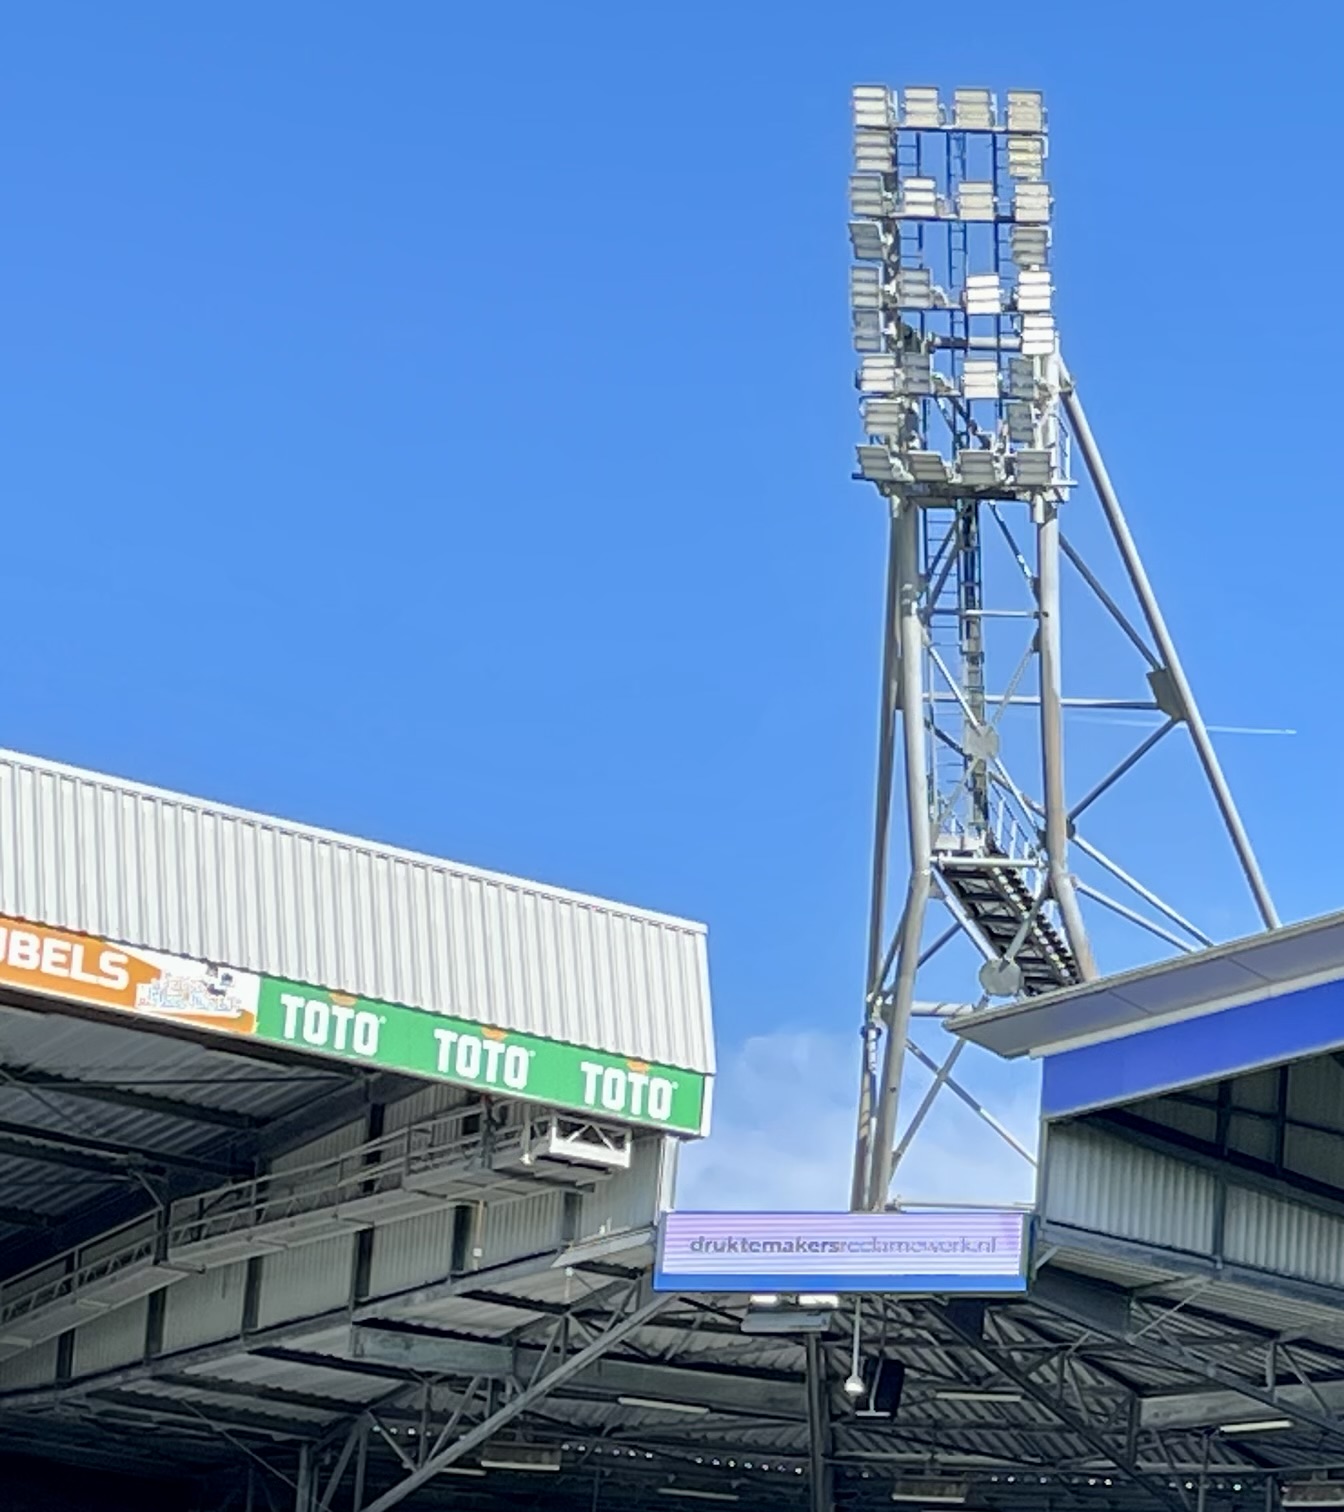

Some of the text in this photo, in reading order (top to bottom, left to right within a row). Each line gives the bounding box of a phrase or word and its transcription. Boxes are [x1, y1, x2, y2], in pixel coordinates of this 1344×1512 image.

[0, 926, 130, 991] BELS
[280, 993, 381, 1057] TOTO
[434, 1028, 531, 1090] TOTO
[581, 1061, 674, 1121] TOTO
